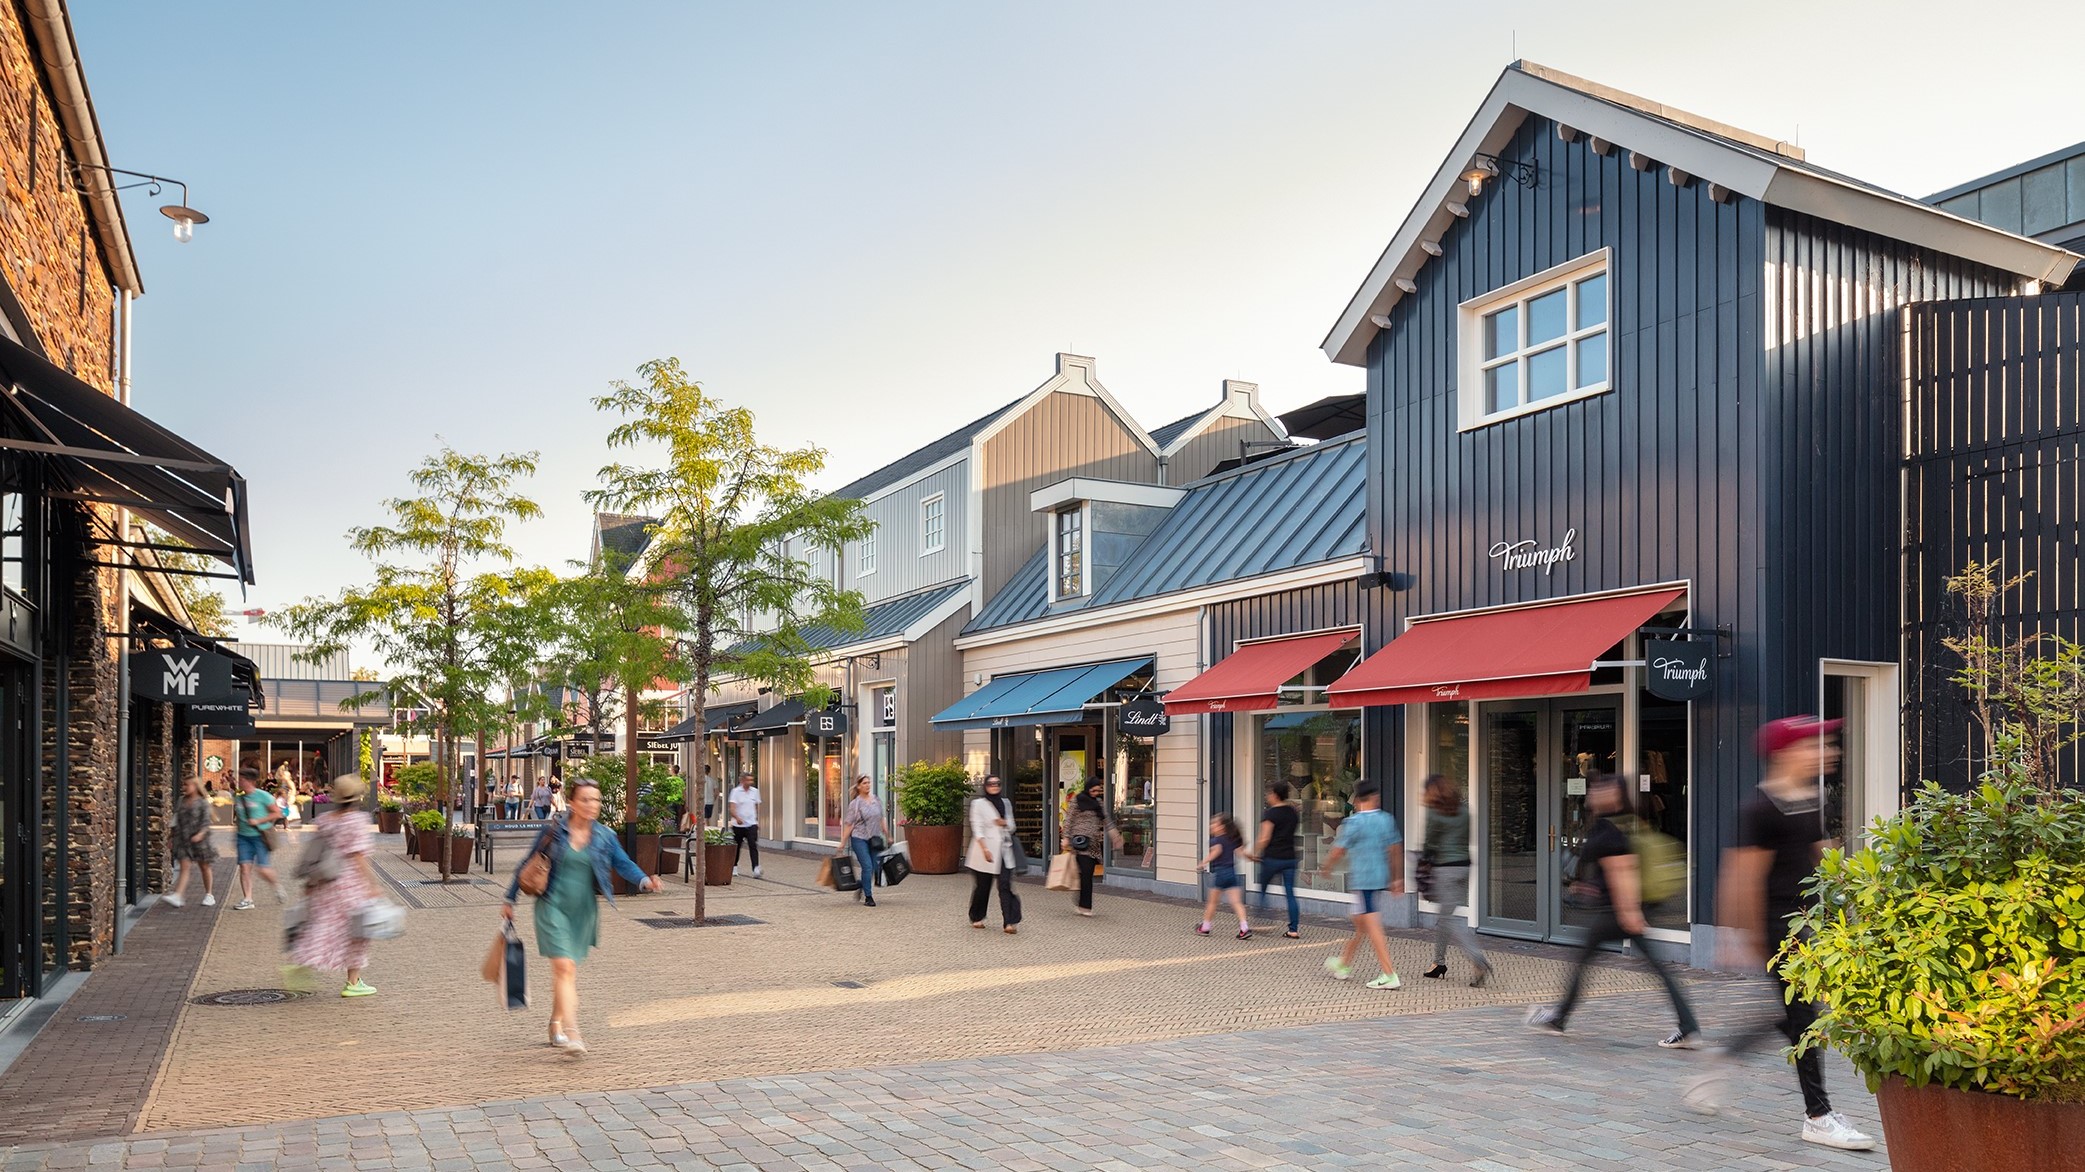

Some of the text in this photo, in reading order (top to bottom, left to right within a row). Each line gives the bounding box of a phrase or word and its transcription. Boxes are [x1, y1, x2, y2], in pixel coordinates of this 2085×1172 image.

[1488, 528, 1576, 575] Triumph
[161, 654, 200, 696] WMF
[1653, 657, 1707, 688] Triumph
[1431, 684, 1460, 700] Triumph
[191, 704, 243, 712] PUREWHITE
[1124, 711, 1159, 725] Lindt
